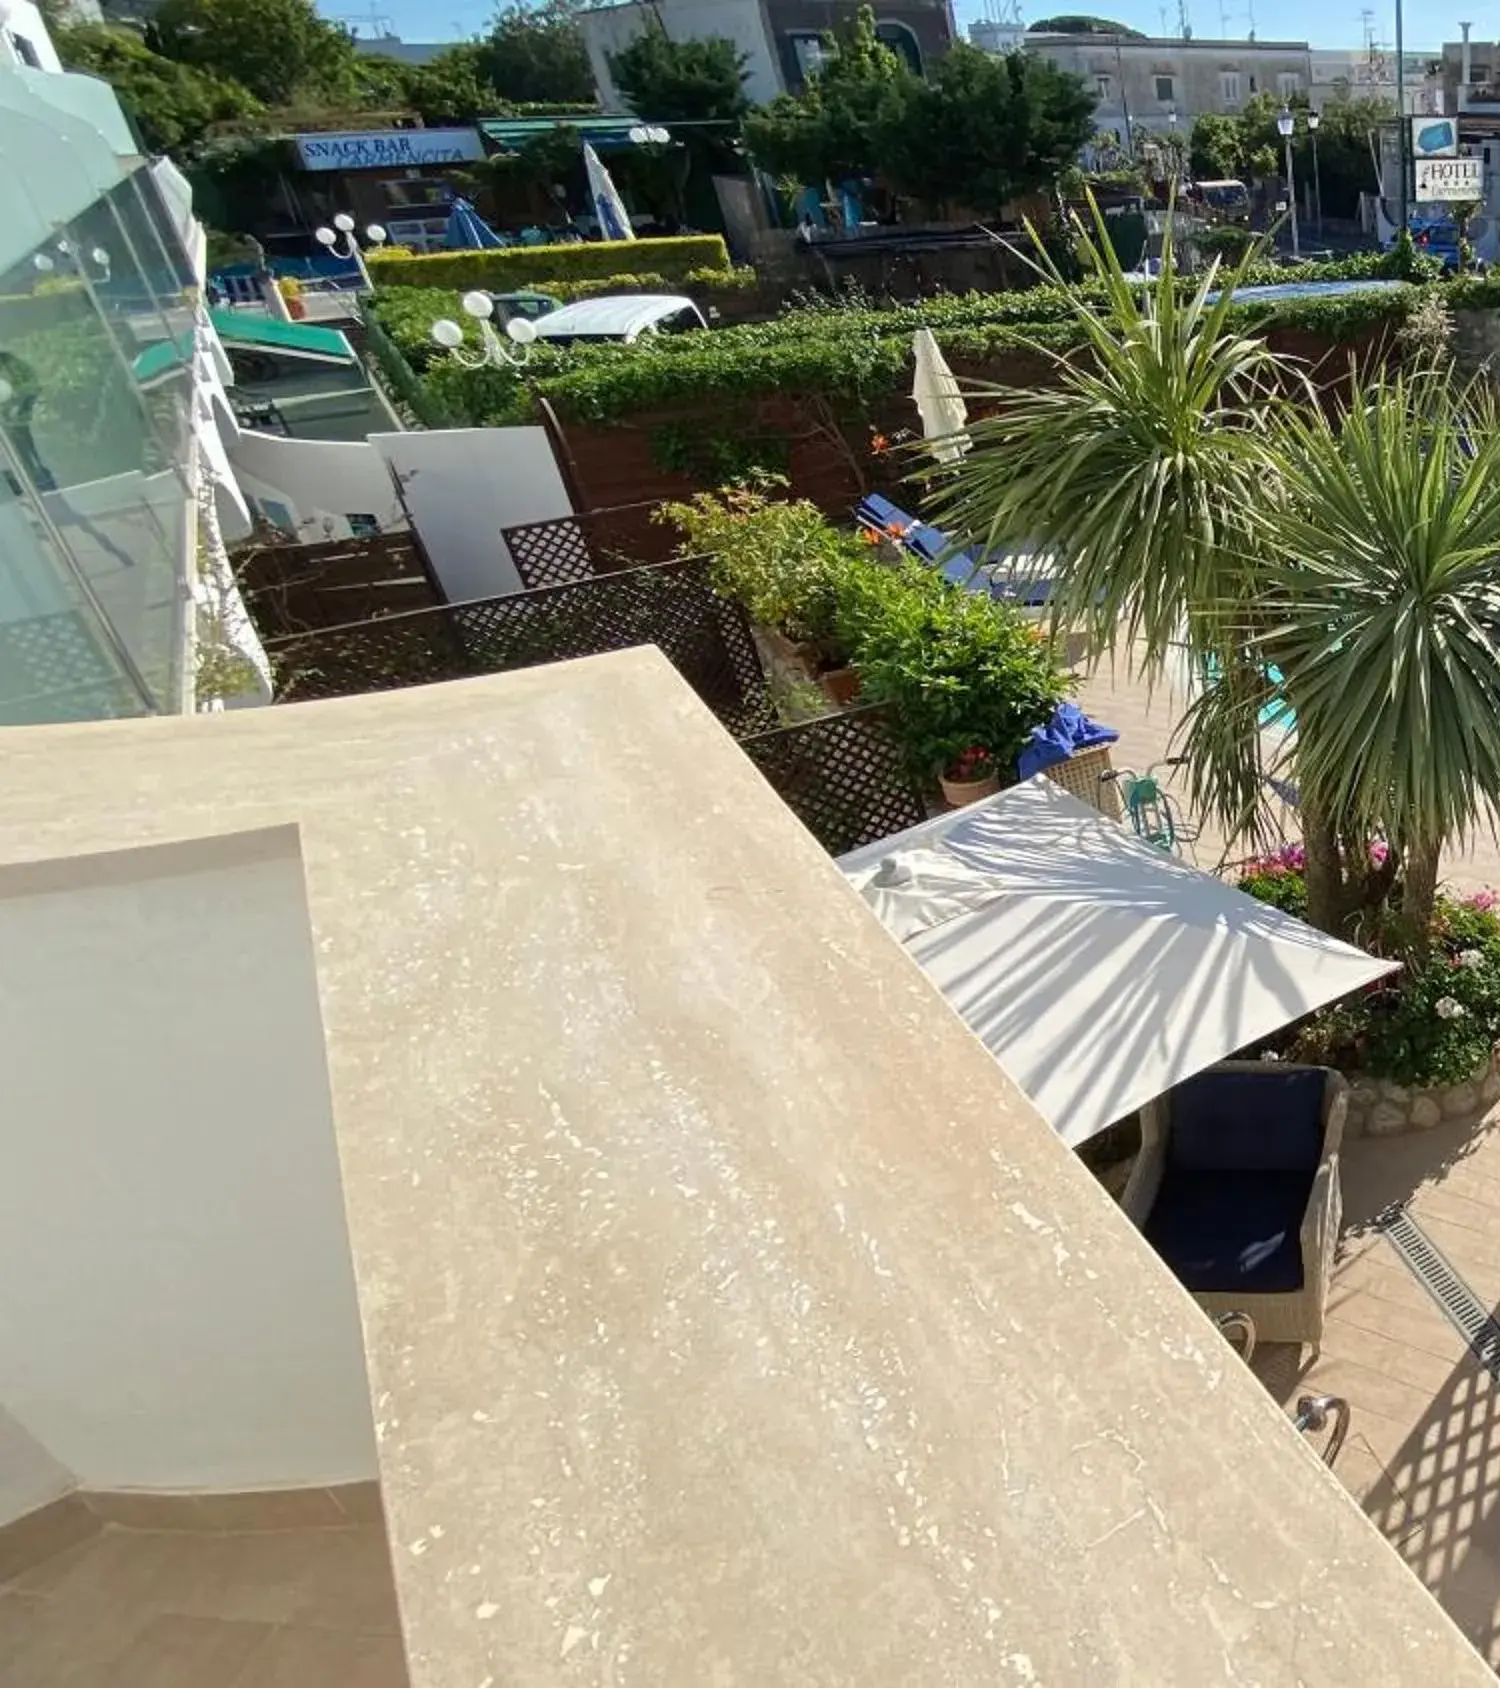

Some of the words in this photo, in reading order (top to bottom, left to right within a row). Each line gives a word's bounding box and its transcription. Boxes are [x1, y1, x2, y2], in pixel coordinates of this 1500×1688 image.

[304, 139, 369, 157] SNACK
[373, 137, 411, 152] BAR
[337, 148, 465, 167] CARMENCITA
[1431, 163, 1478, 180] HOTEL
